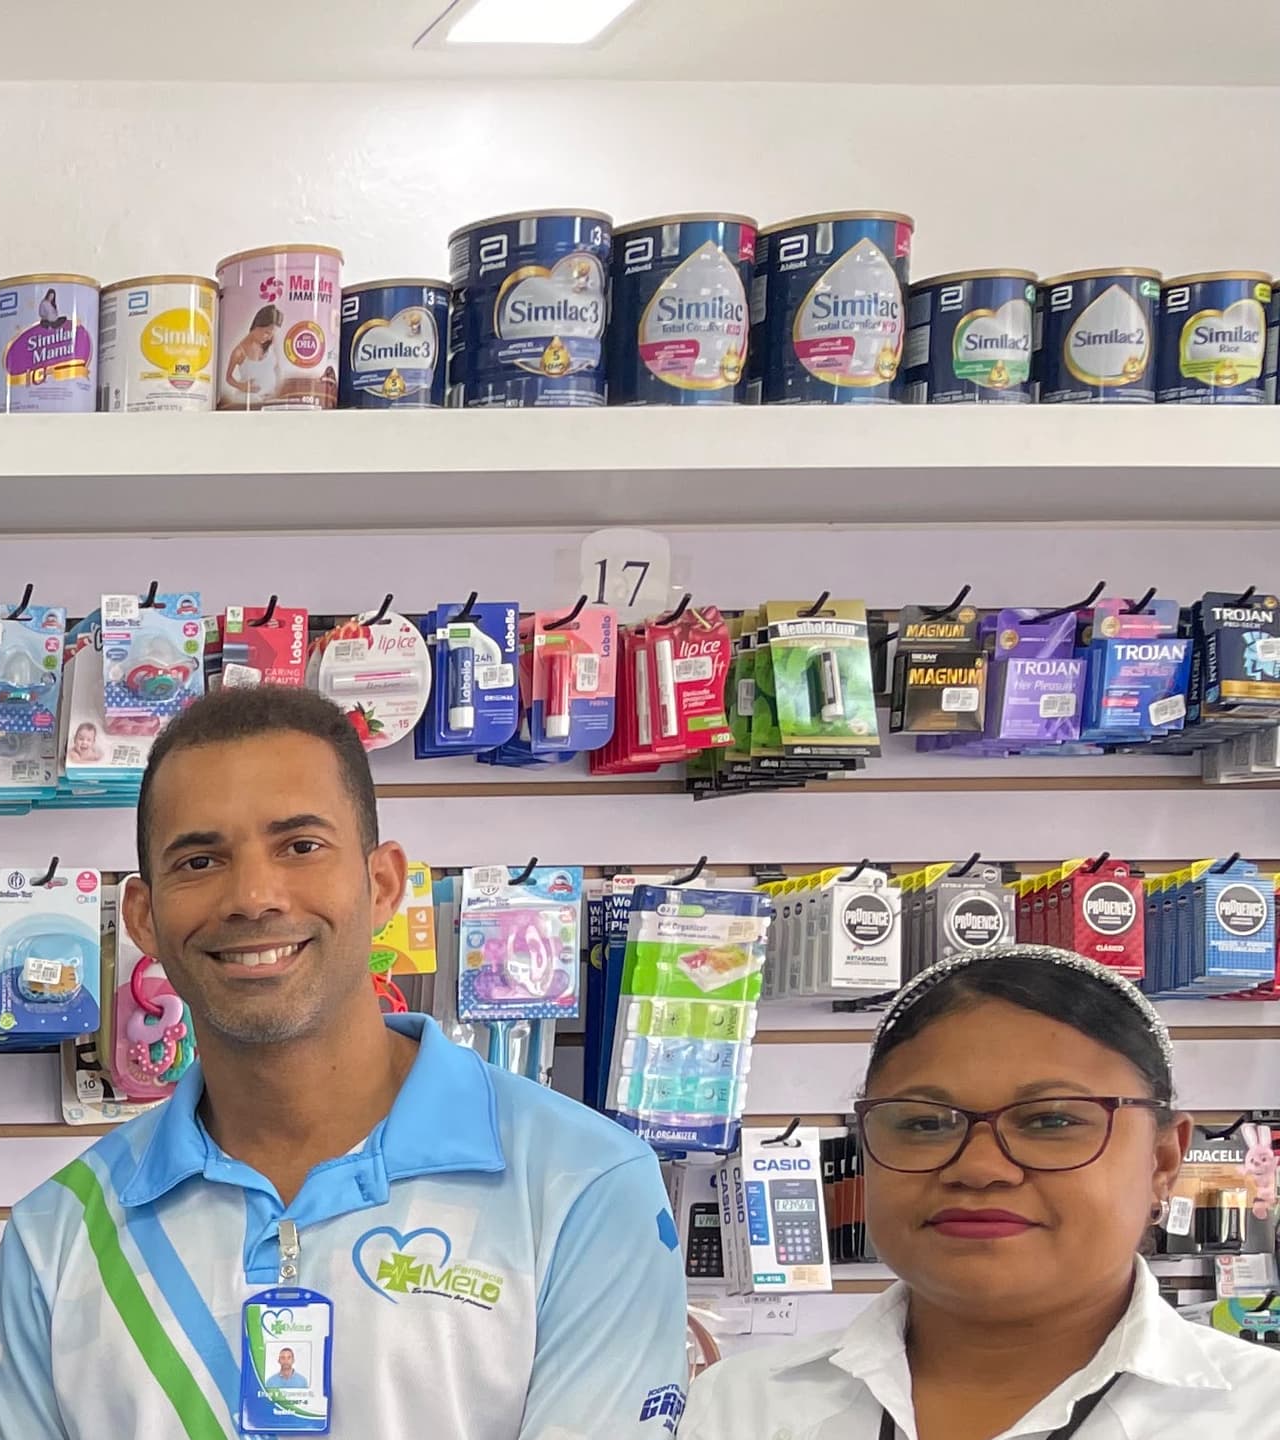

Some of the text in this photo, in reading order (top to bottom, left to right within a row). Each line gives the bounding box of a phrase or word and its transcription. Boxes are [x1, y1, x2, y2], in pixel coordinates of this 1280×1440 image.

[657, 295, 743, 323] Similac
[812, 292, 898, 319] Similac
[151, 327, 208, 347] Similac
[296, 339, 316, 350] DHA
[1193, 325, 1259, 346] Similac
[32, 344, 75, 364] Mama
[590, 558, 651, 606] 17
[1211, 607, 1273, 623] TROJAN
[505, 609, 516, 653] Labello
[601, 615, 611, 658] Labello
[777, 621, 857, 636] Mentholatum
[905, 624, 965, 638] MAGNUM
[290, 615, 304, 665] Labello
[475, 653, 493, 663] 24h
[1114, 644, 1187, 661] TROJAN
[264, 668, 301, 677] CARING
[909, 668, 984, 685] MAGNUM
[1014, 661, 1081, 676] TROJAN
[460, 660, 471, 704] Labello
[398, 719, 409, 729] 15
[752, 1158, 811, 1171] CASIO
[1184, 1149, 1244, 1162] URACELL
[720, 1168, 731, 1225] CASIO
[733, 1167, 745, 1223] CASIO
